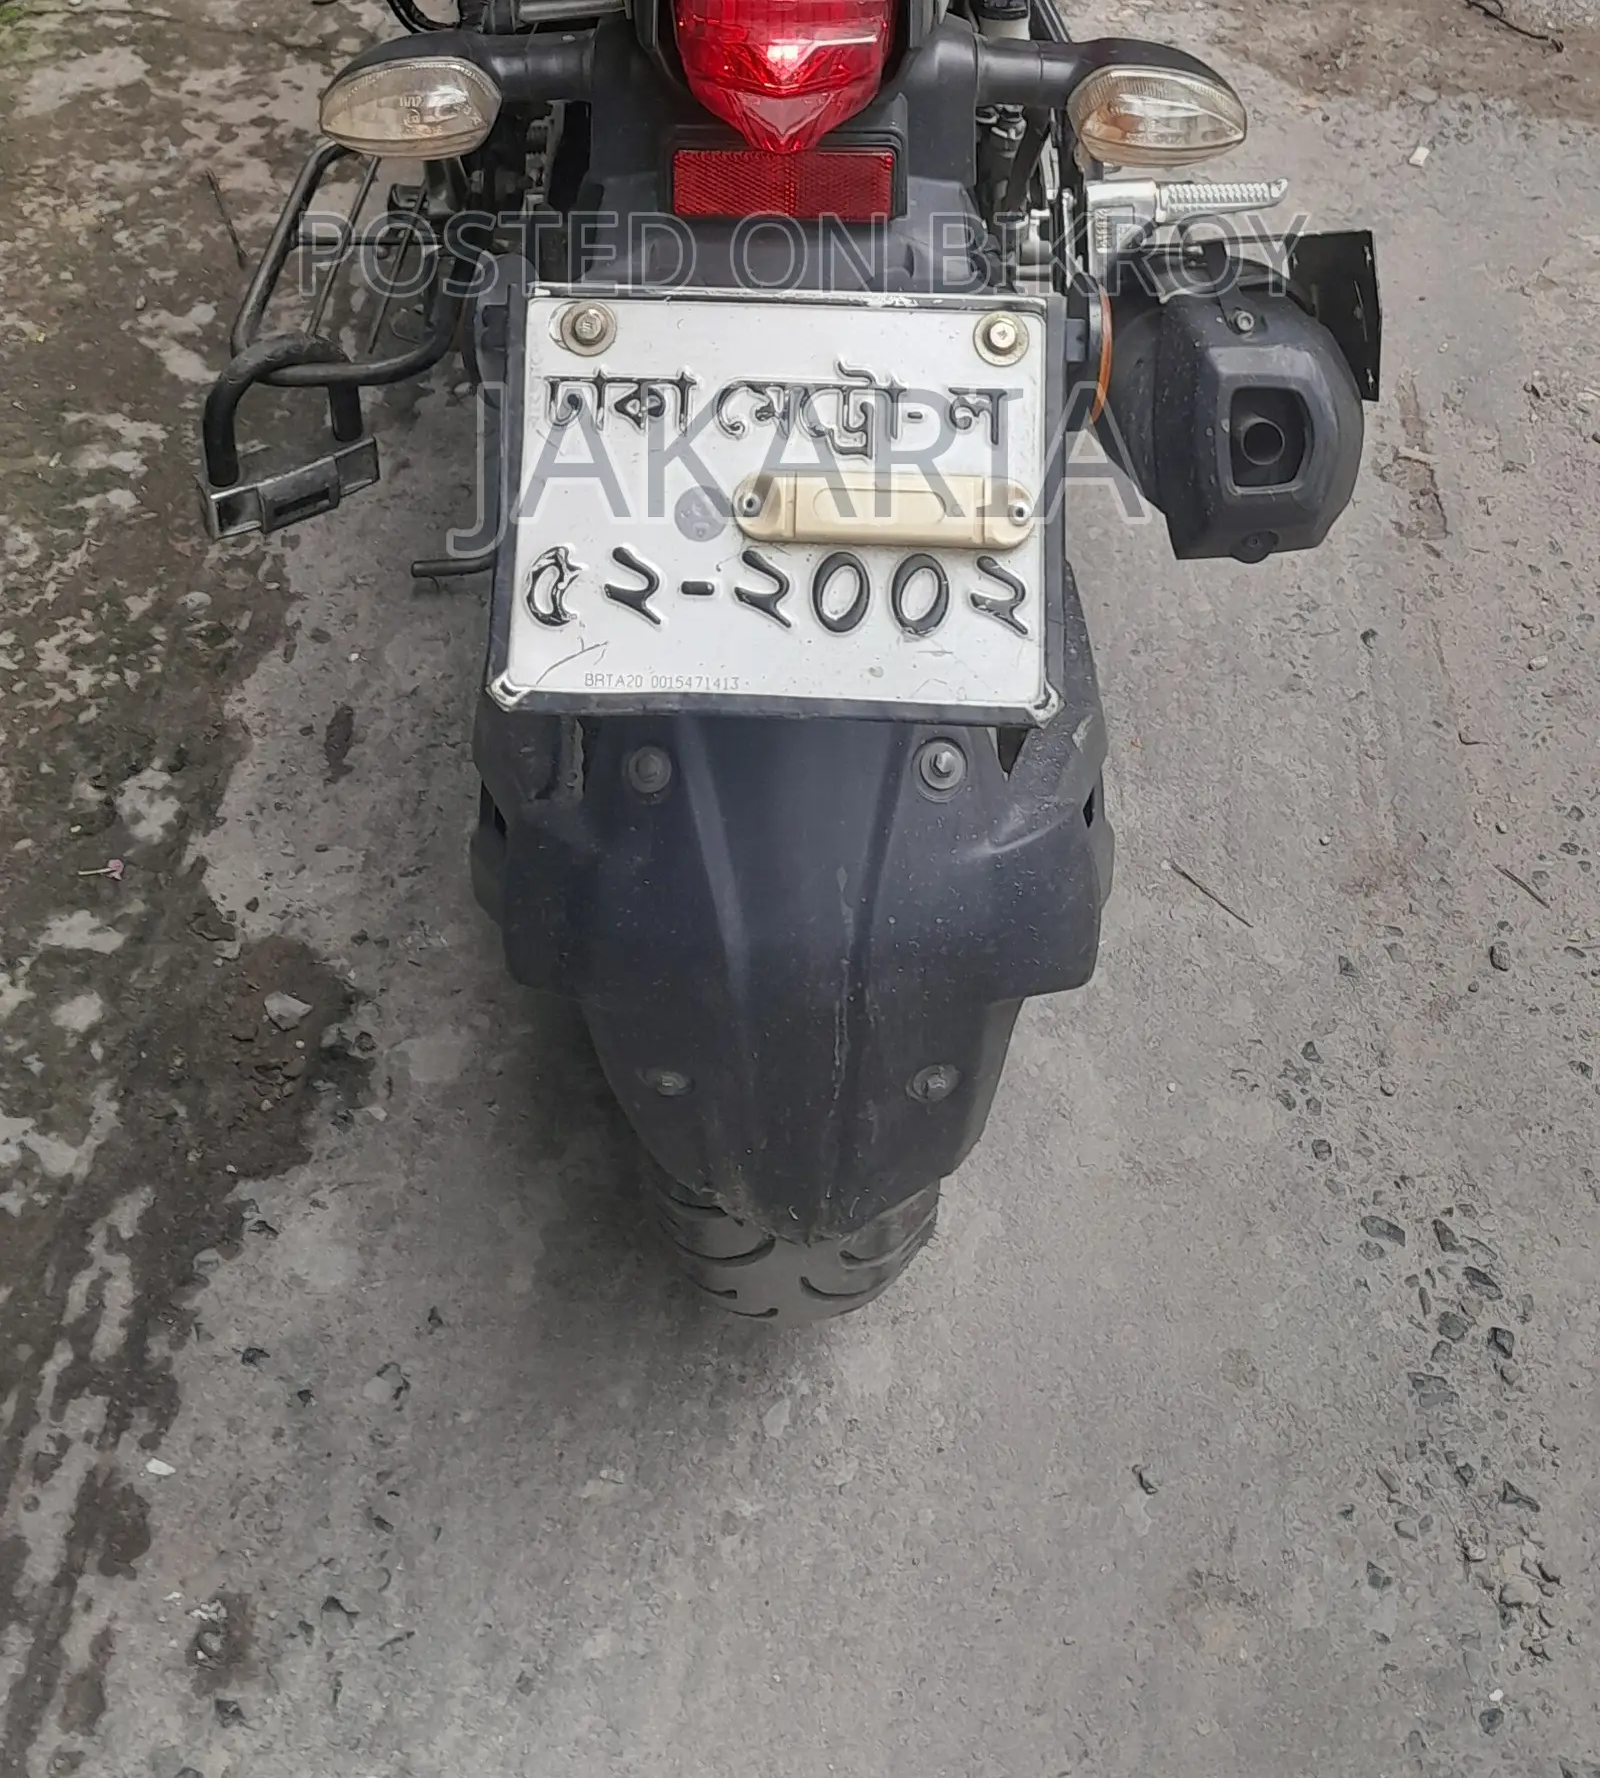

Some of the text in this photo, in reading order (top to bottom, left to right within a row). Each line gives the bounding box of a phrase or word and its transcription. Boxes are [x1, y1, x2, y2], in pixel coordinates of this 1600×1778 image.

[544, 368, 698, 434] ঢাকা
[584, 672, 740, 691] BRTA20 0015471413
